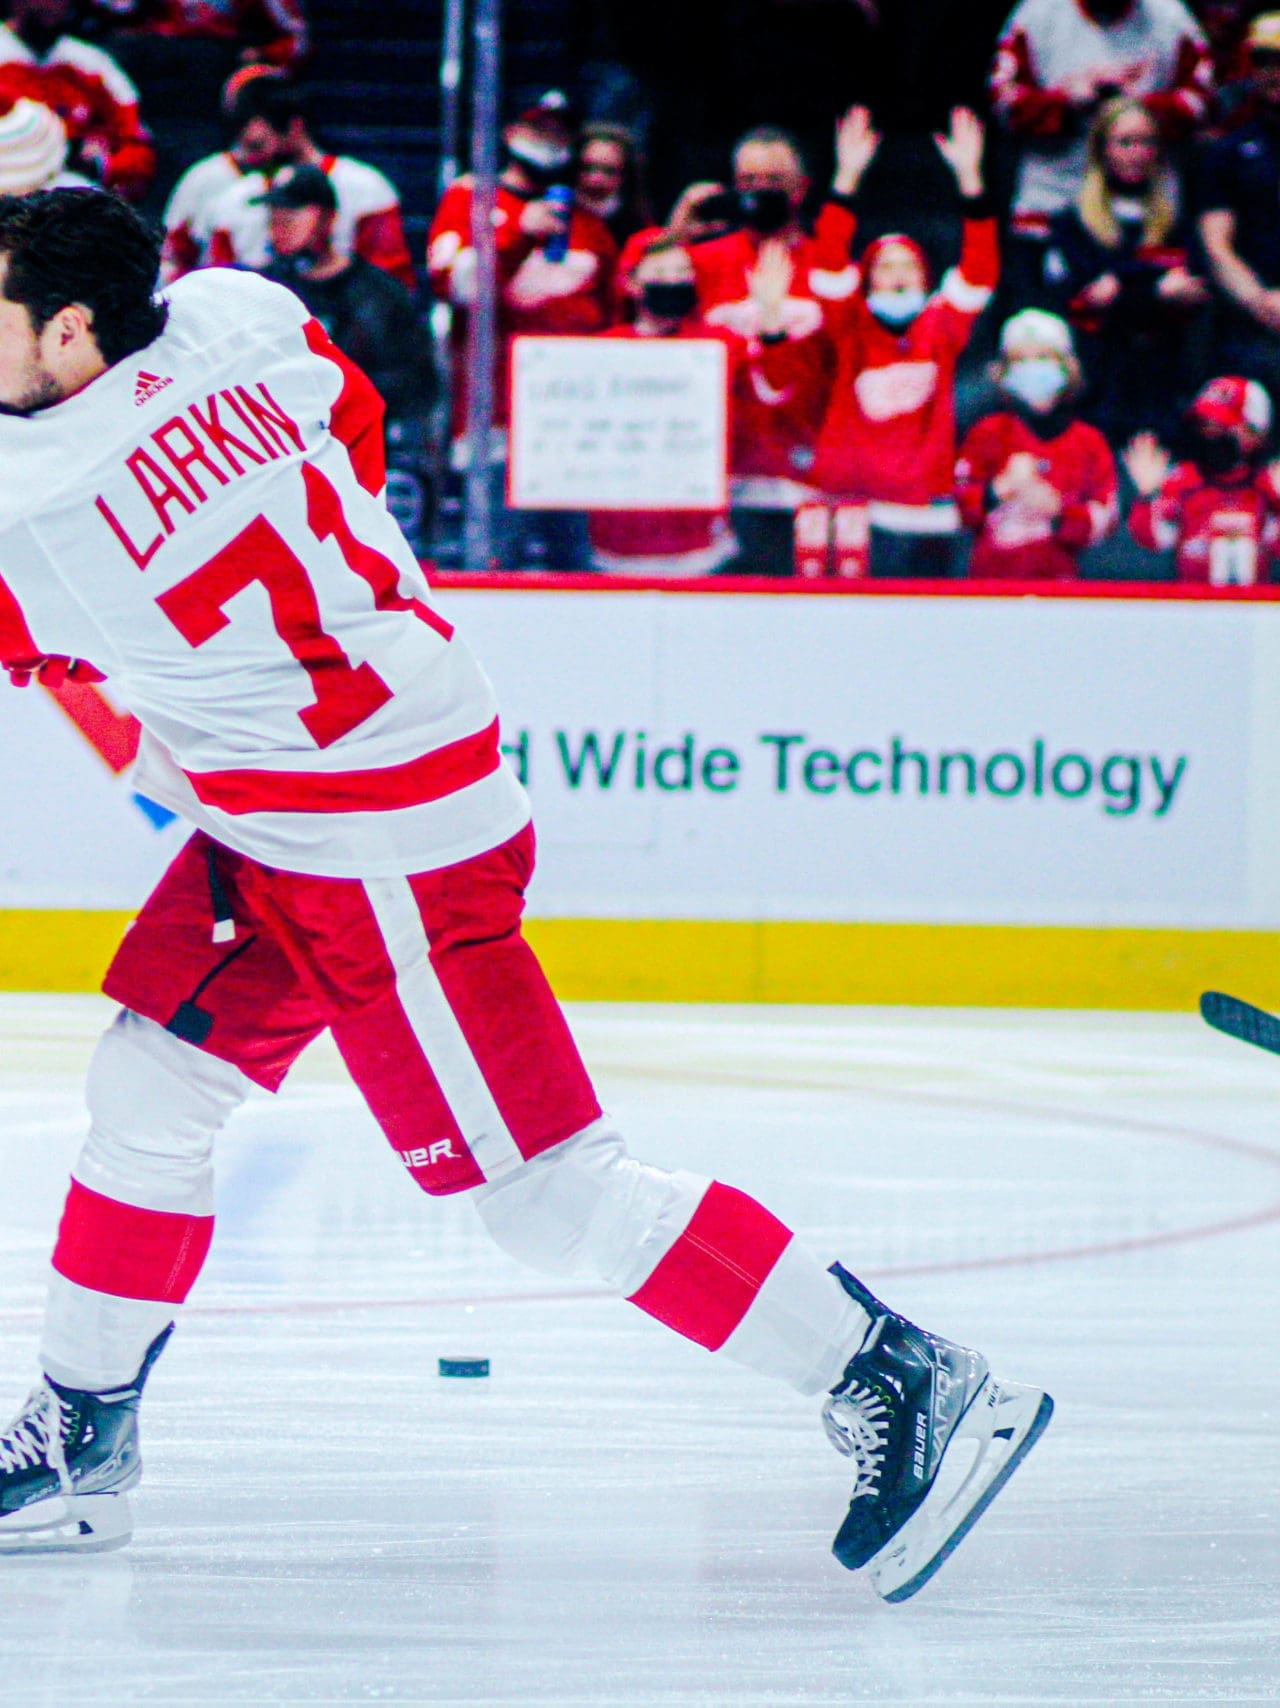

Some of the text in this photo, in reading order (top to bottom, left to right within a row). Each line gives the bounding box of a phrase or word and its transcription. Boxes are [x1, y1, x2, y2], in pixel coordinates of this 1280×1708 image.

[134, 376, 174, 407] adidas
[94, 381, 308, 572] LARKIN
[154, 460, 456, 751] 71
[554, 730, 741, 793] Wide
[758, 733, 1188, 817] Technology
[912, 1411, 928, 1480] BAUER
